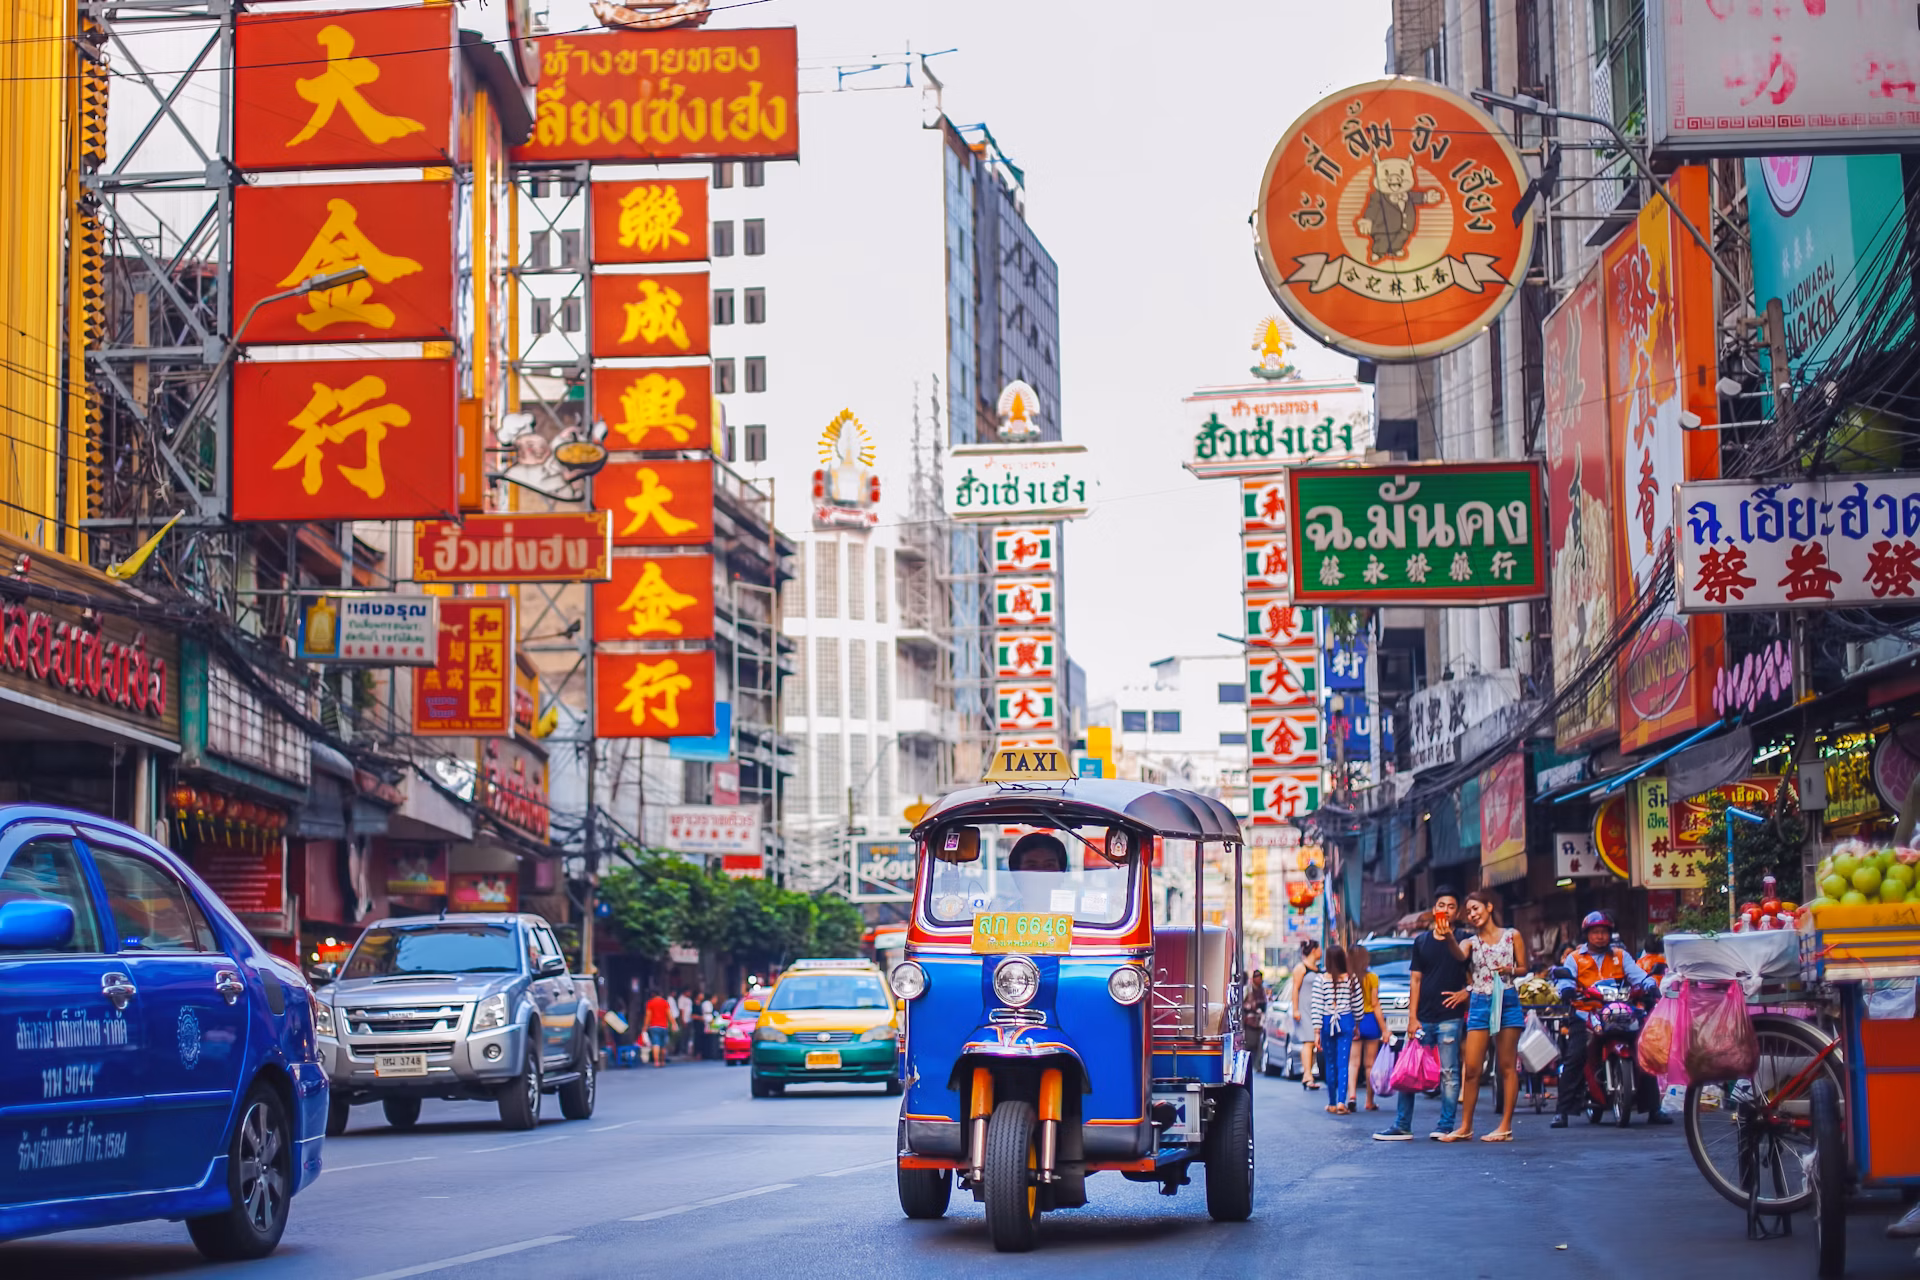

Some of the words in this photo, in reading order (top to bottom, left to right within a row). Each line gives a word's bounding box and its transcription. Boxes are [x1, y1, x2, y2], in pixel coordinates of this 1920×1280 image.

[543, 38, 761, 76] ห้างขายทอง
[525, 77, 787, 147] ลี่ยงเซ่งเฮง
[272, 25, 426, 499] 大金行
[1787, 254, 1835, 313] YAOWARAJ
[1787, 284, 1838, 362] NGKOK
[615, 184, 698, 729] 聯成興大金行
[1305, 475, 1528, 551] ฉ.มั่นคง
[347, 602, 427, 622] แสงอรุณ
[1001, 752, 1058, 773] TAXI
[1016, 916, 1067, 936] 6646
[65, 1064, 95, 1095] 9044
[400, 1056, 421, 1066] 3748
